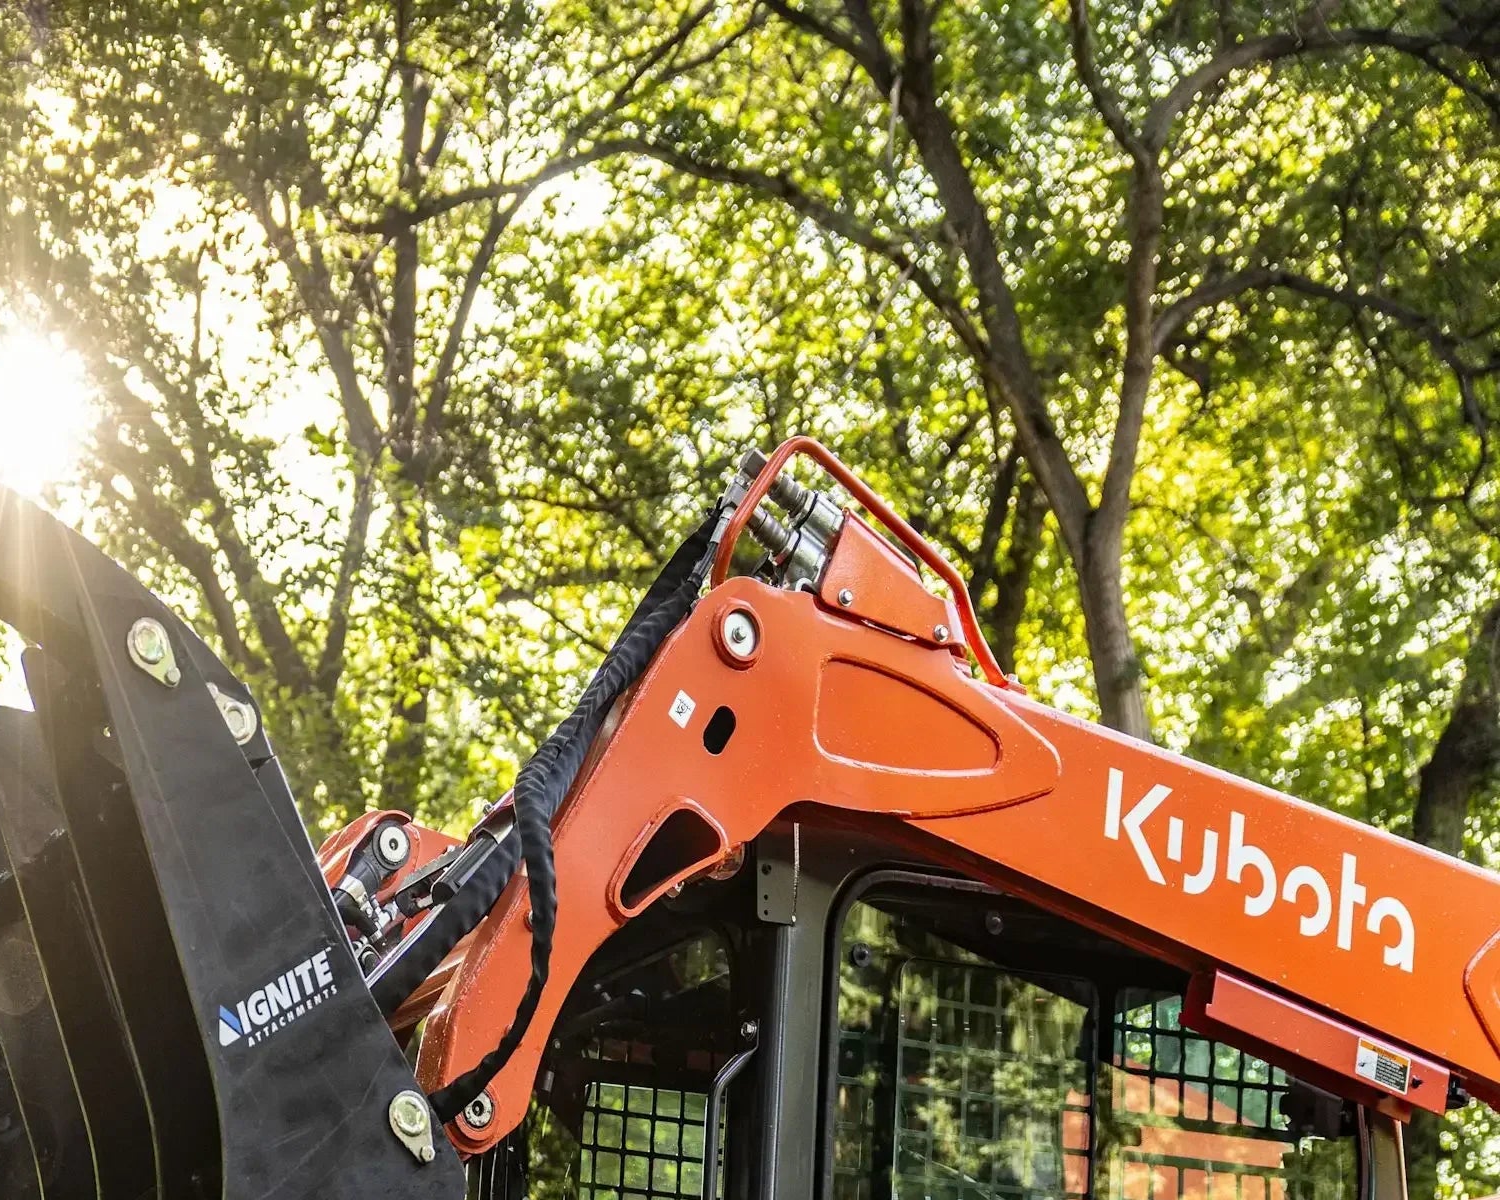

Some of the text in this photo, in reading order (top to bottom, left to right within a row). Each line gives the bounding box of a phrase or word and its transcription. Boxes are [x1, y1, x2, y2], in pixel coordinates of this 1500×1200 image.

[1103, 766, 1415, 973] Kubota
[236, 950, 333, 1035] IGNITE
[248, 984, 337, 1048] ATTACHMENTS
